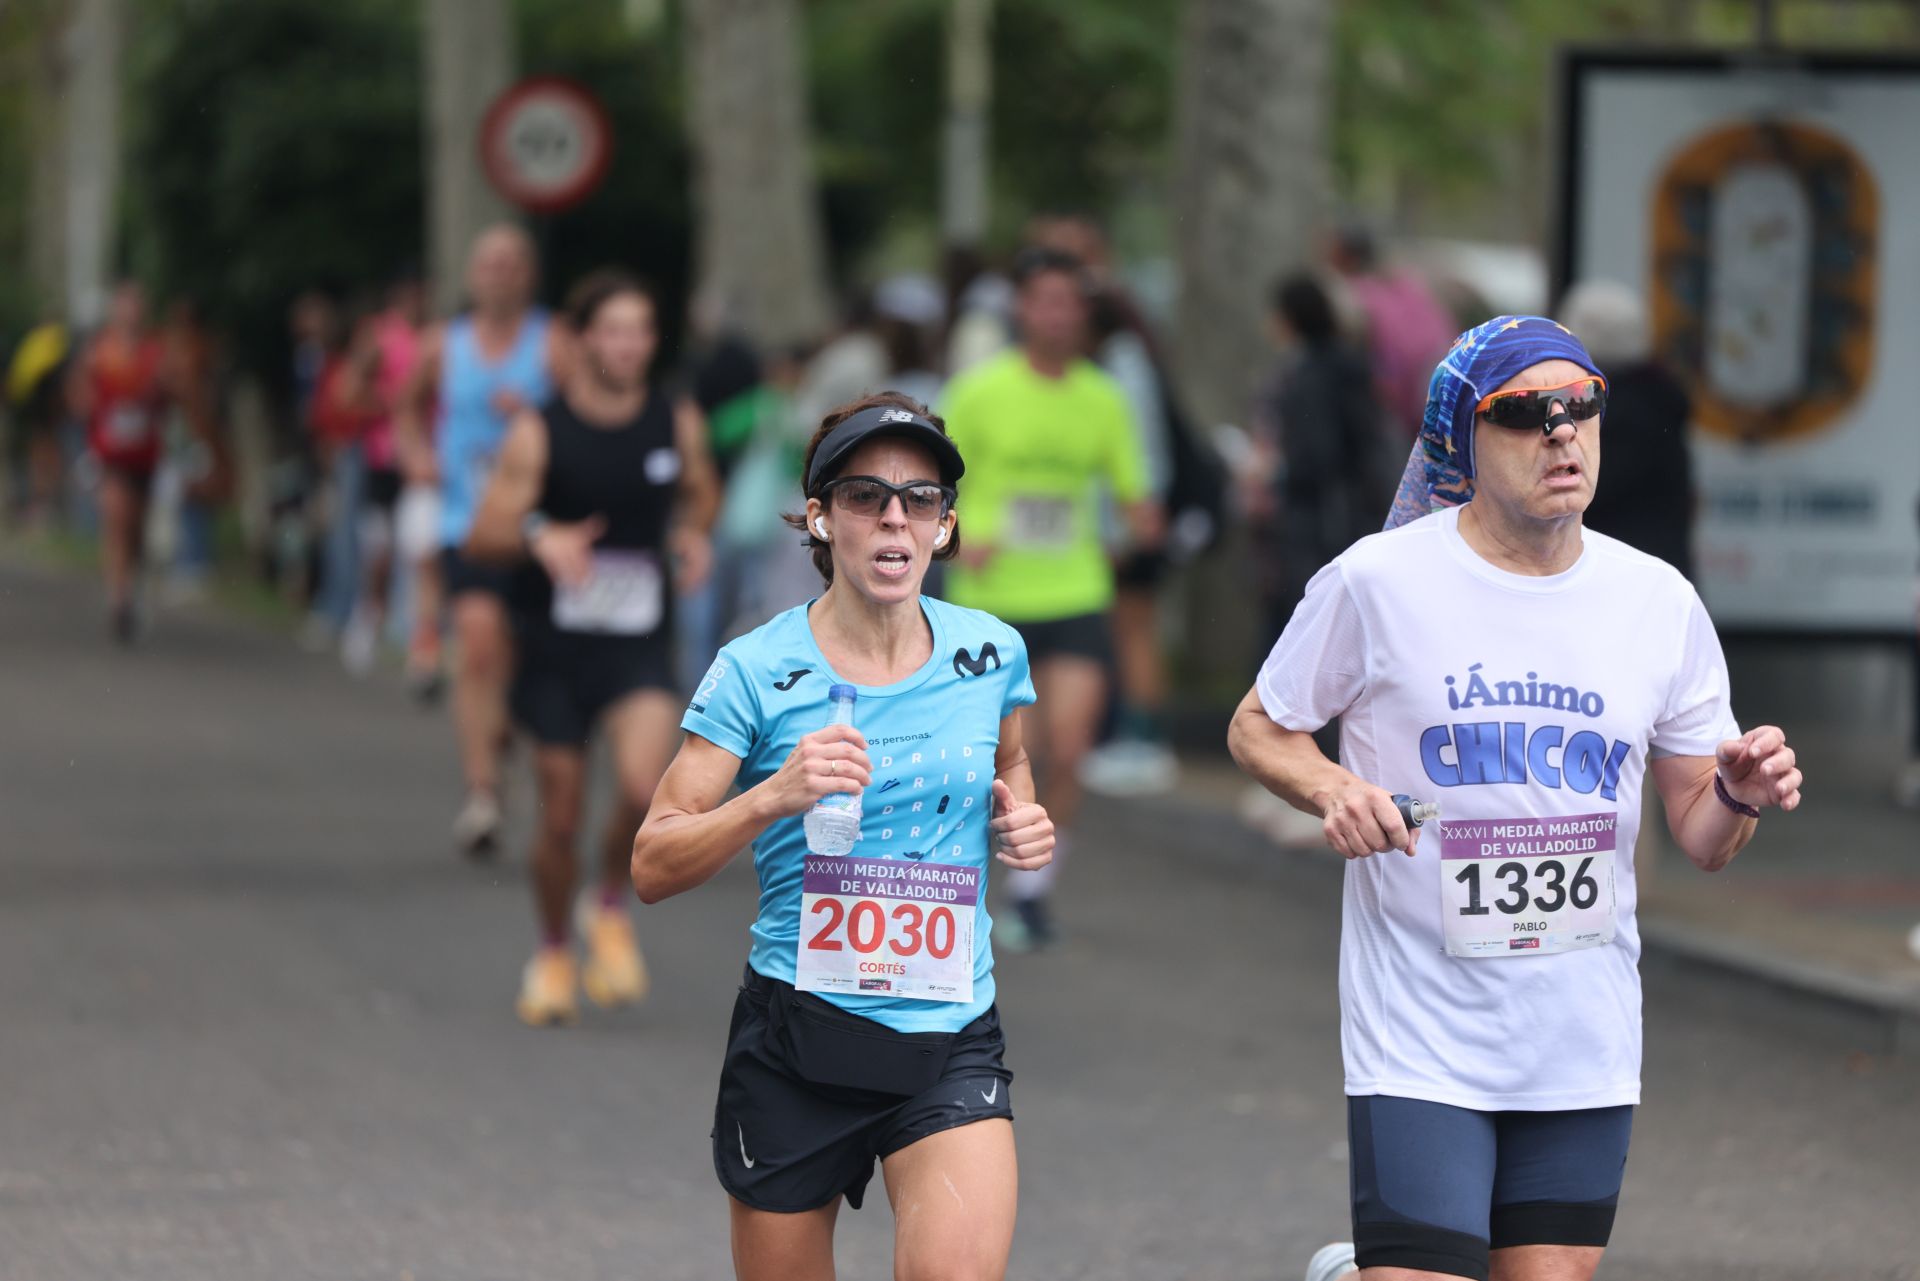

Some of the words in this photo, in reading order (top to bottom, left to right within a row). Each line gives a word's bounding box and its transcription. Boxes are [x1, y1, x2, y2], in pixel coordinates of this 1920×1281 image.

[882, 732, 932, 747] personas.
[1444, 827, 1487, 840] XXXVI
[1493, 824, 1545, 839] MEDIA
[1549, 816, 1615, 836] MARATÓN
[1481, 843, 1501, 856] DE
[1506, 837, 1597, 855] VALLADOLID
[807, 861, 848, 876] XXXVI
[854, 863, 906, 880] MEDIA
[910, 868, 976, 886] MARATÓN
[840, 880, 861, 894] DE
[866, 882, 957, 901] VALLADOLID
[1455, 857, 1598, 915] 1336
[808, 898, 956, 960] 2030
[1513, 921, 1548, 932] PABLO
[859, 962, 907, 975] CORTÉS
